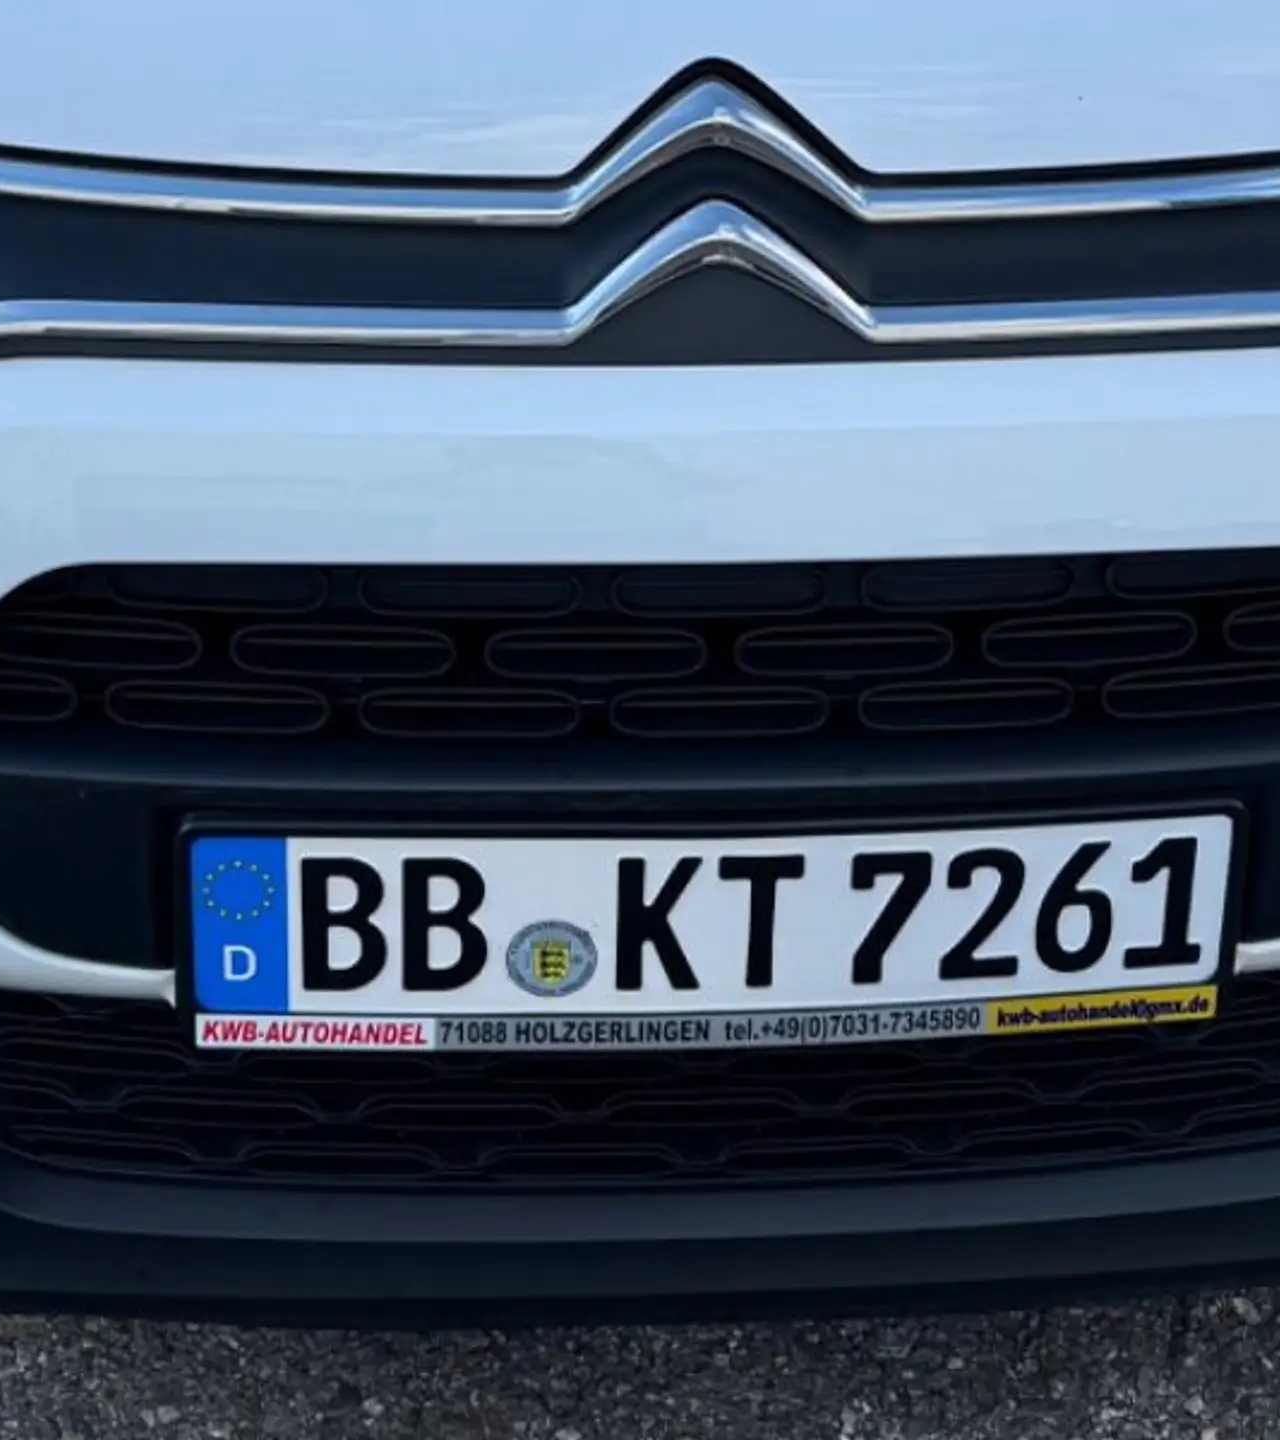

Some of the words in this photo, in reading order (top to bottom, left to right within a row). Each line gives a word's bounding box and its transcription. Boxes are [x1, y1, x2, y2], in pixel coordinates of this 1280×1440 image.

[300, 857, 488, 991] BB
[615, 854, 805, 990] KT
[851, 836, 1201, 984] 7261
[223, 945, 257, 981] D
[202, 1019, 428, 1045] KWB-AUTOHANDEL
[440, 1021, 508, 1045] 71088
[515, 1019, 711, 1045] HOLZGERLINGEN
